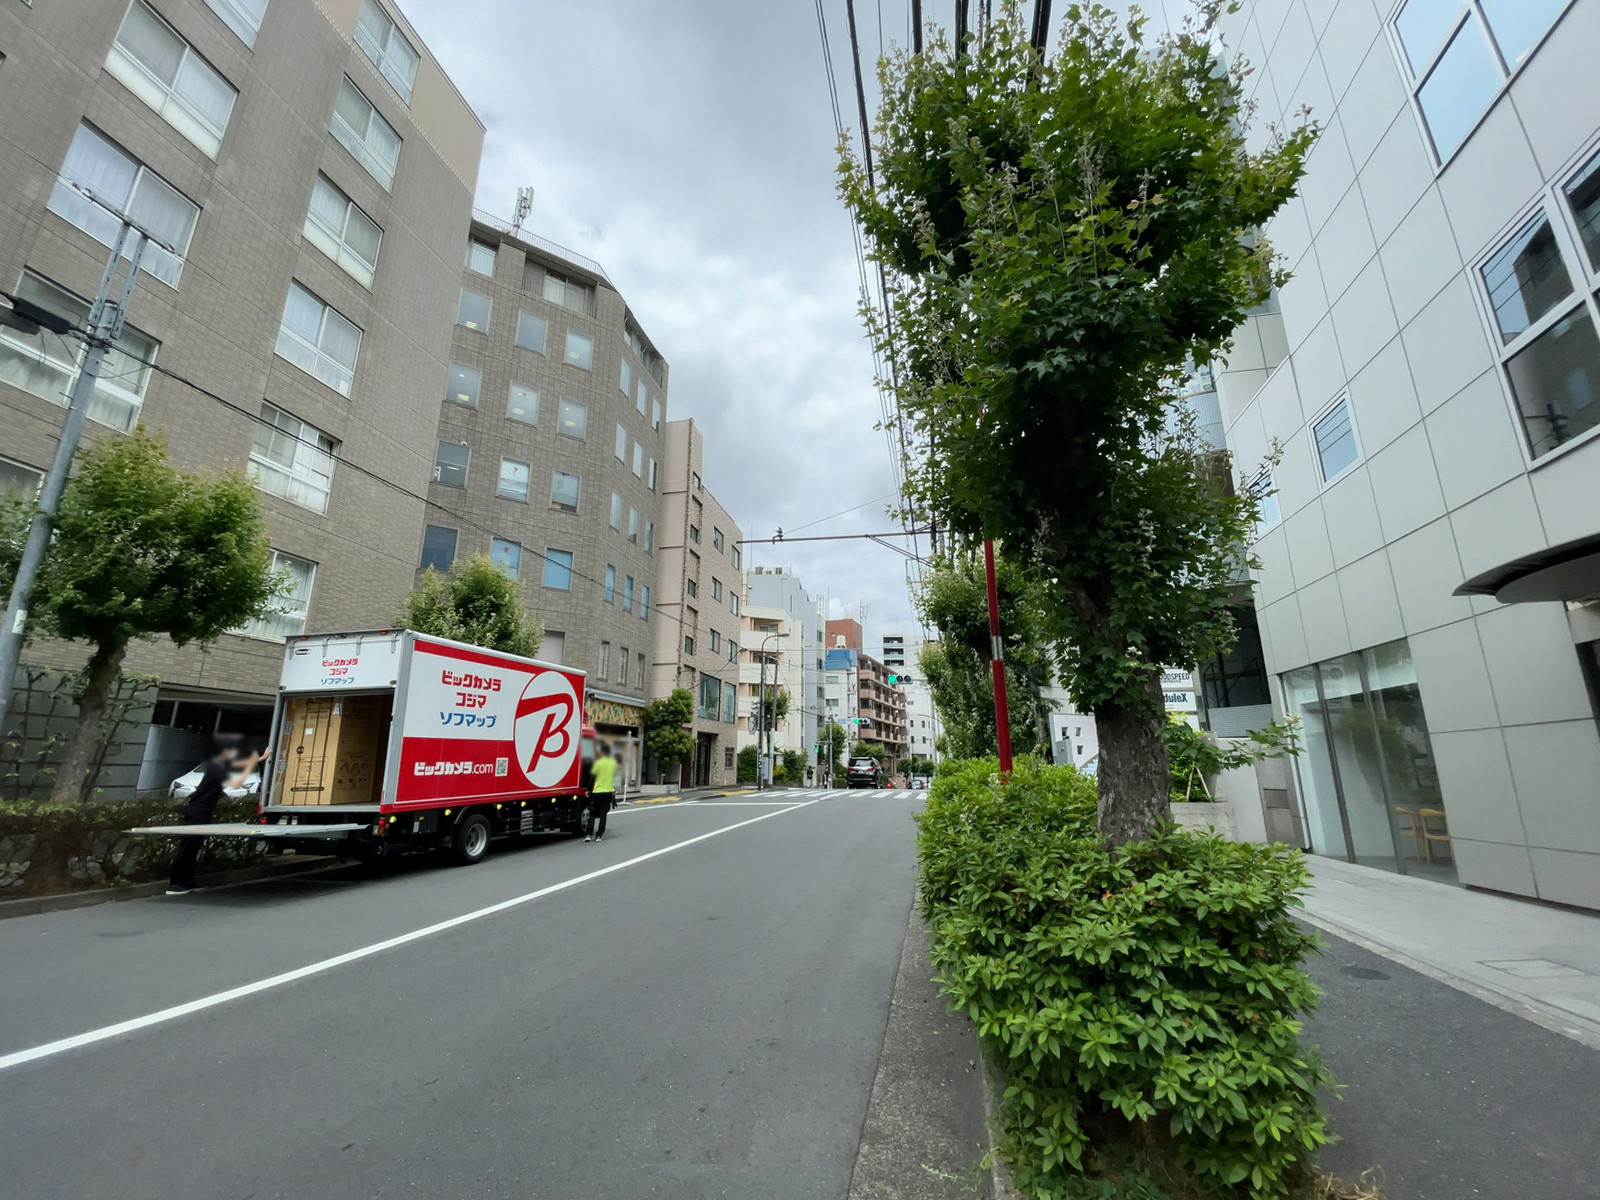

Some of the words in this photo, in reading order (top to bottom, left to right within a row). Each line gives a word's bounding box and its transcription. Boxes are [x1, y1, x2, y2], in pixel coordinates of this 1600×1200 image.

[322, 658, 359, 667] ビックカメラ
[329, 668, 348, 676] コジマ
[320, 677, 355, 686] ソフマップ
[441, 670, 502, 692] ビックカメラ
[455, 692, 487, 708] コジマ
[440, 712, 497, 728] ソフマップ
[414, 761, 494, 776] ビックカメラ.com
